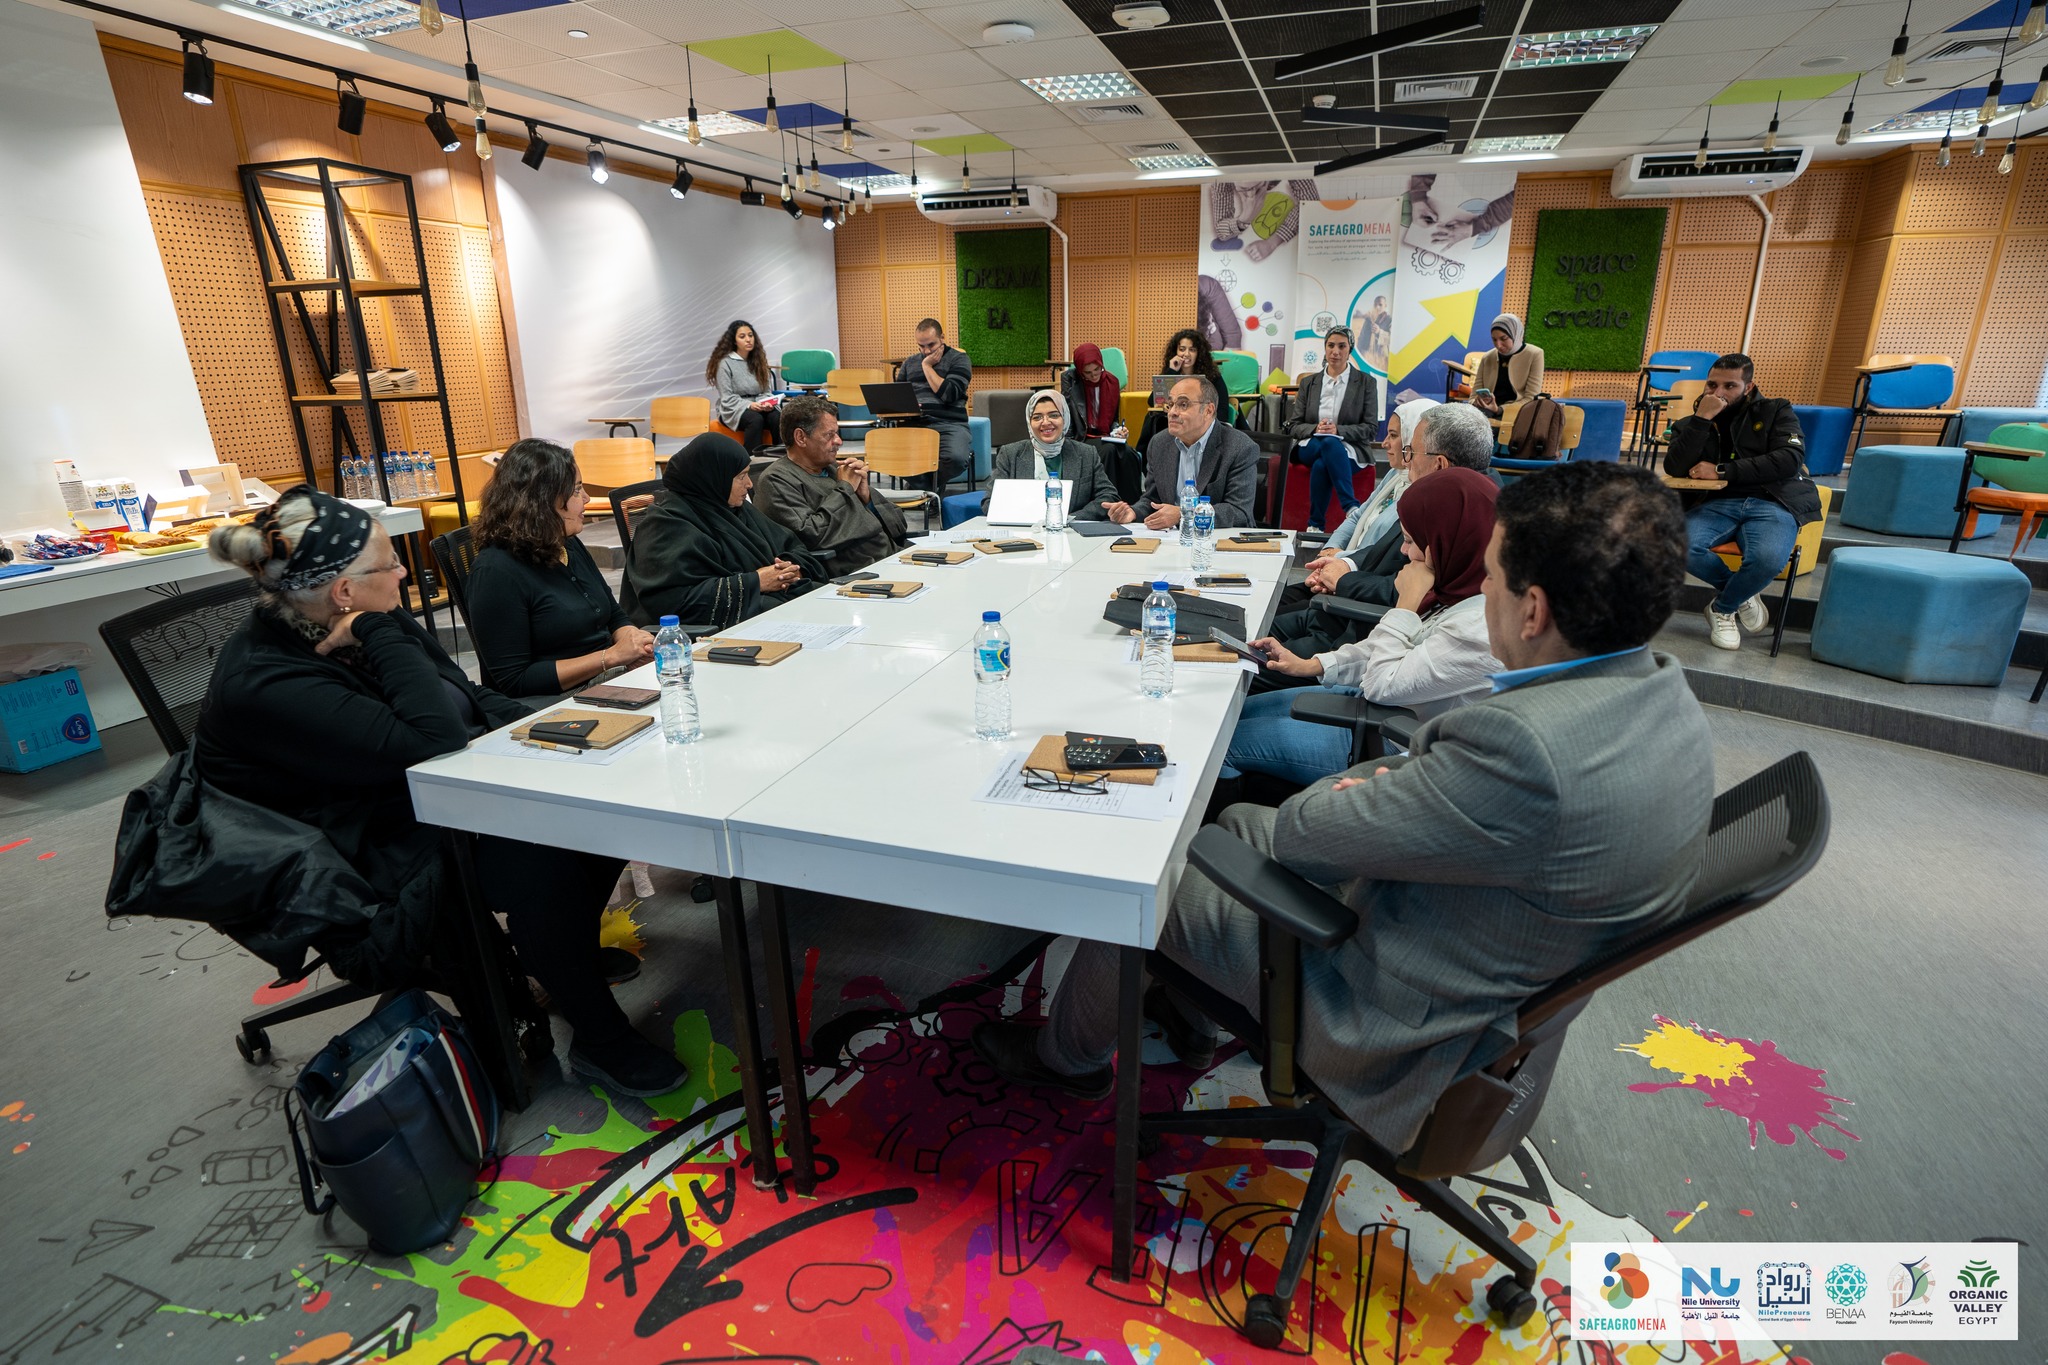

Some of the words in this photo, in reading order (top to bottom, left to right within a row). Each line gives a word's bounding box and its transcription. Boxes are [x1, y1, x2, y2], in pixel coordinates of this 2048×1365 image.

[1309, 223, 1391, 236] SAFEAGROMENA
[963, 266, 1041, 289] DREAM
[1557, 252, 1637, 282] space
[1575, 281, 1603, 303] to
[987, 306, 1013, 329] EA
[1544, 304, 1631, 329] create
